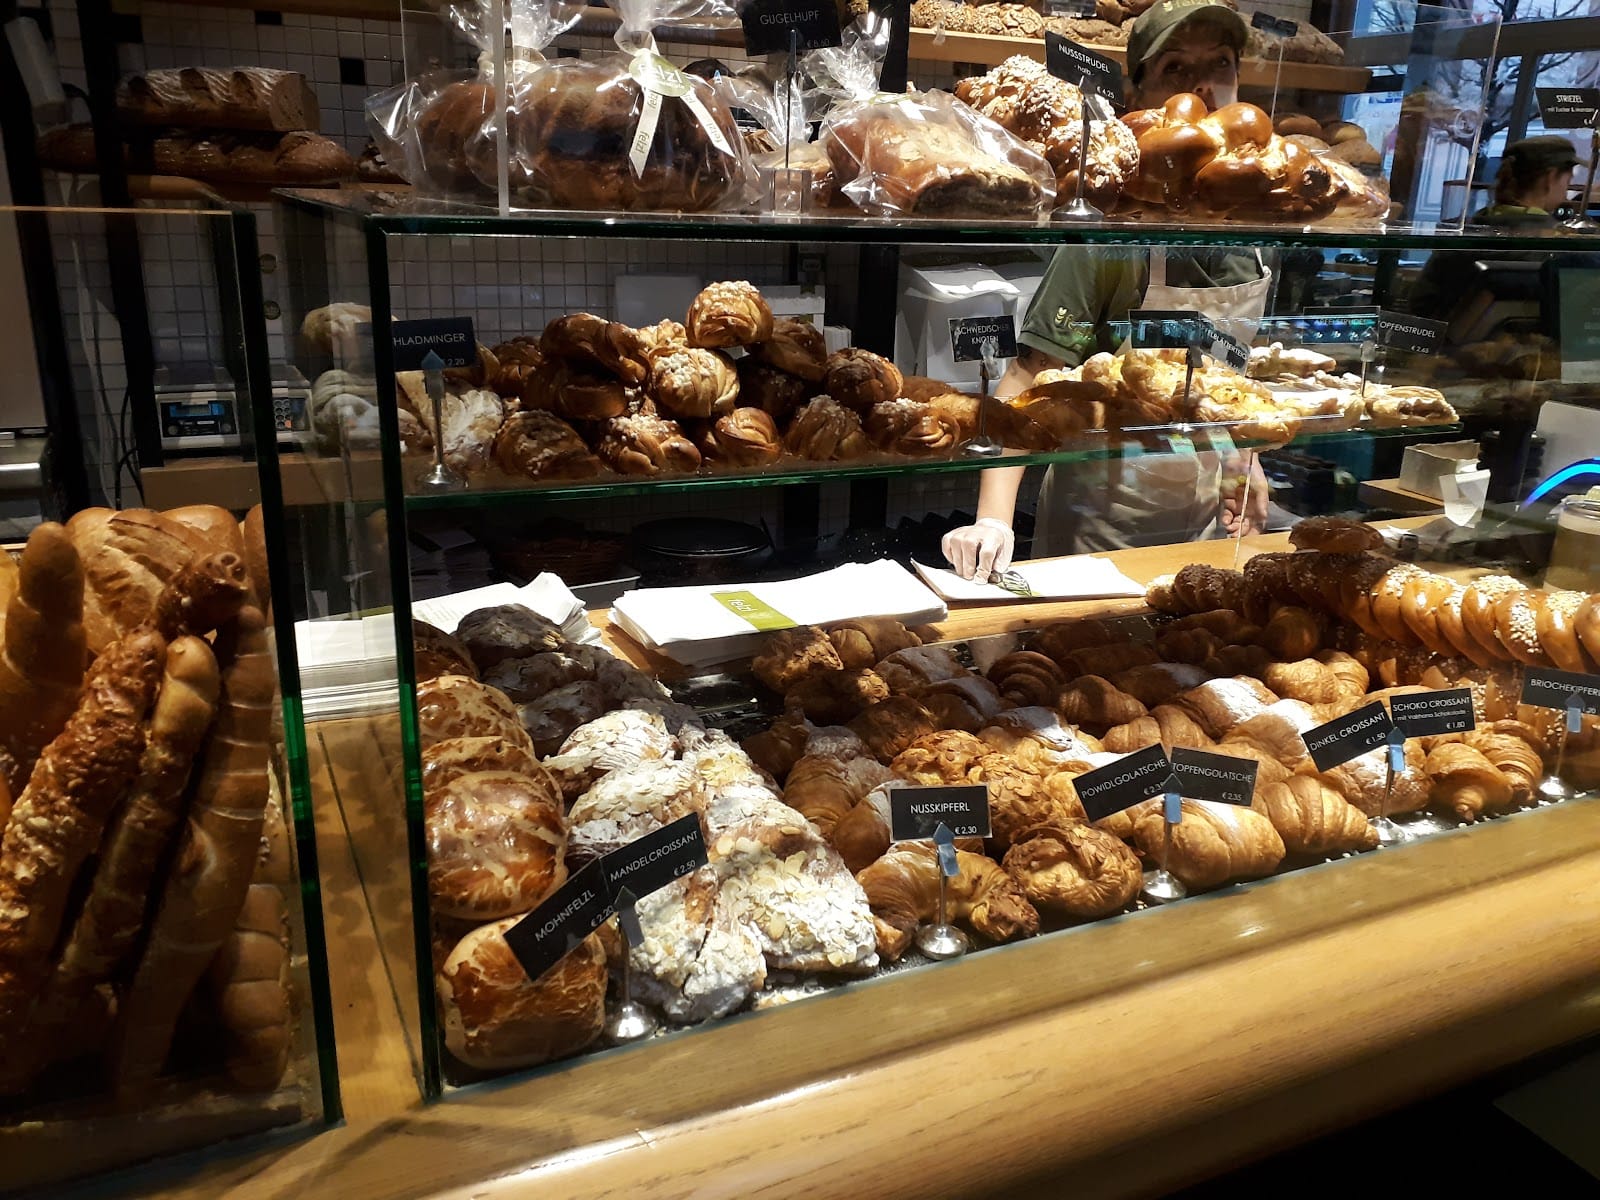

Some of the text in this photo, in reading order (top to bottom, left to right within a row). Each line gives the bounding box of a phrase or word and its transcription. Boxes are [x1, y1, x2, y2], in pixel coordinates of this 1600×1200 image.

[760, 10, 820, 25] GUGELHUPF
[1058, 43, 1110, 74] NUSSSTRUDEL
[1077, 64, 1092, 76] halb
[1556, 94, 1583, 103] STRIEZEL
[635, 131, 650, 154] felzl
[1379, 321, 1436, 338] OPFENSTRUDEL
[393, 332, 465, 346] HLADMINGER
[971, 335, 999, 345] KNOTEN
[1392, 696, 1470, 712] SCHOKO CROISSANT
[1309, 711, 1386, 751] DINKEL CROISSANT
[1372, 732, 1386, 743] 1.50
[1081, 758, 1167, 799] POWIDLGOLATSCHE
[1172, 762, 1253, 783] TOPFENGOLATSCHE
[1228, 792, 1242, 801] 2.35
[911, 802, 970, 814] NUSSKIPFERL
[961, 825, 977, 835] 2.30
[609, 830, 698, 882] MANDELCROISSANT
[680, 859, 696, 874] 2.50
[534, 889, 595, 942] MOHNFELZL
[596, 904, 614, 923] 2.20
